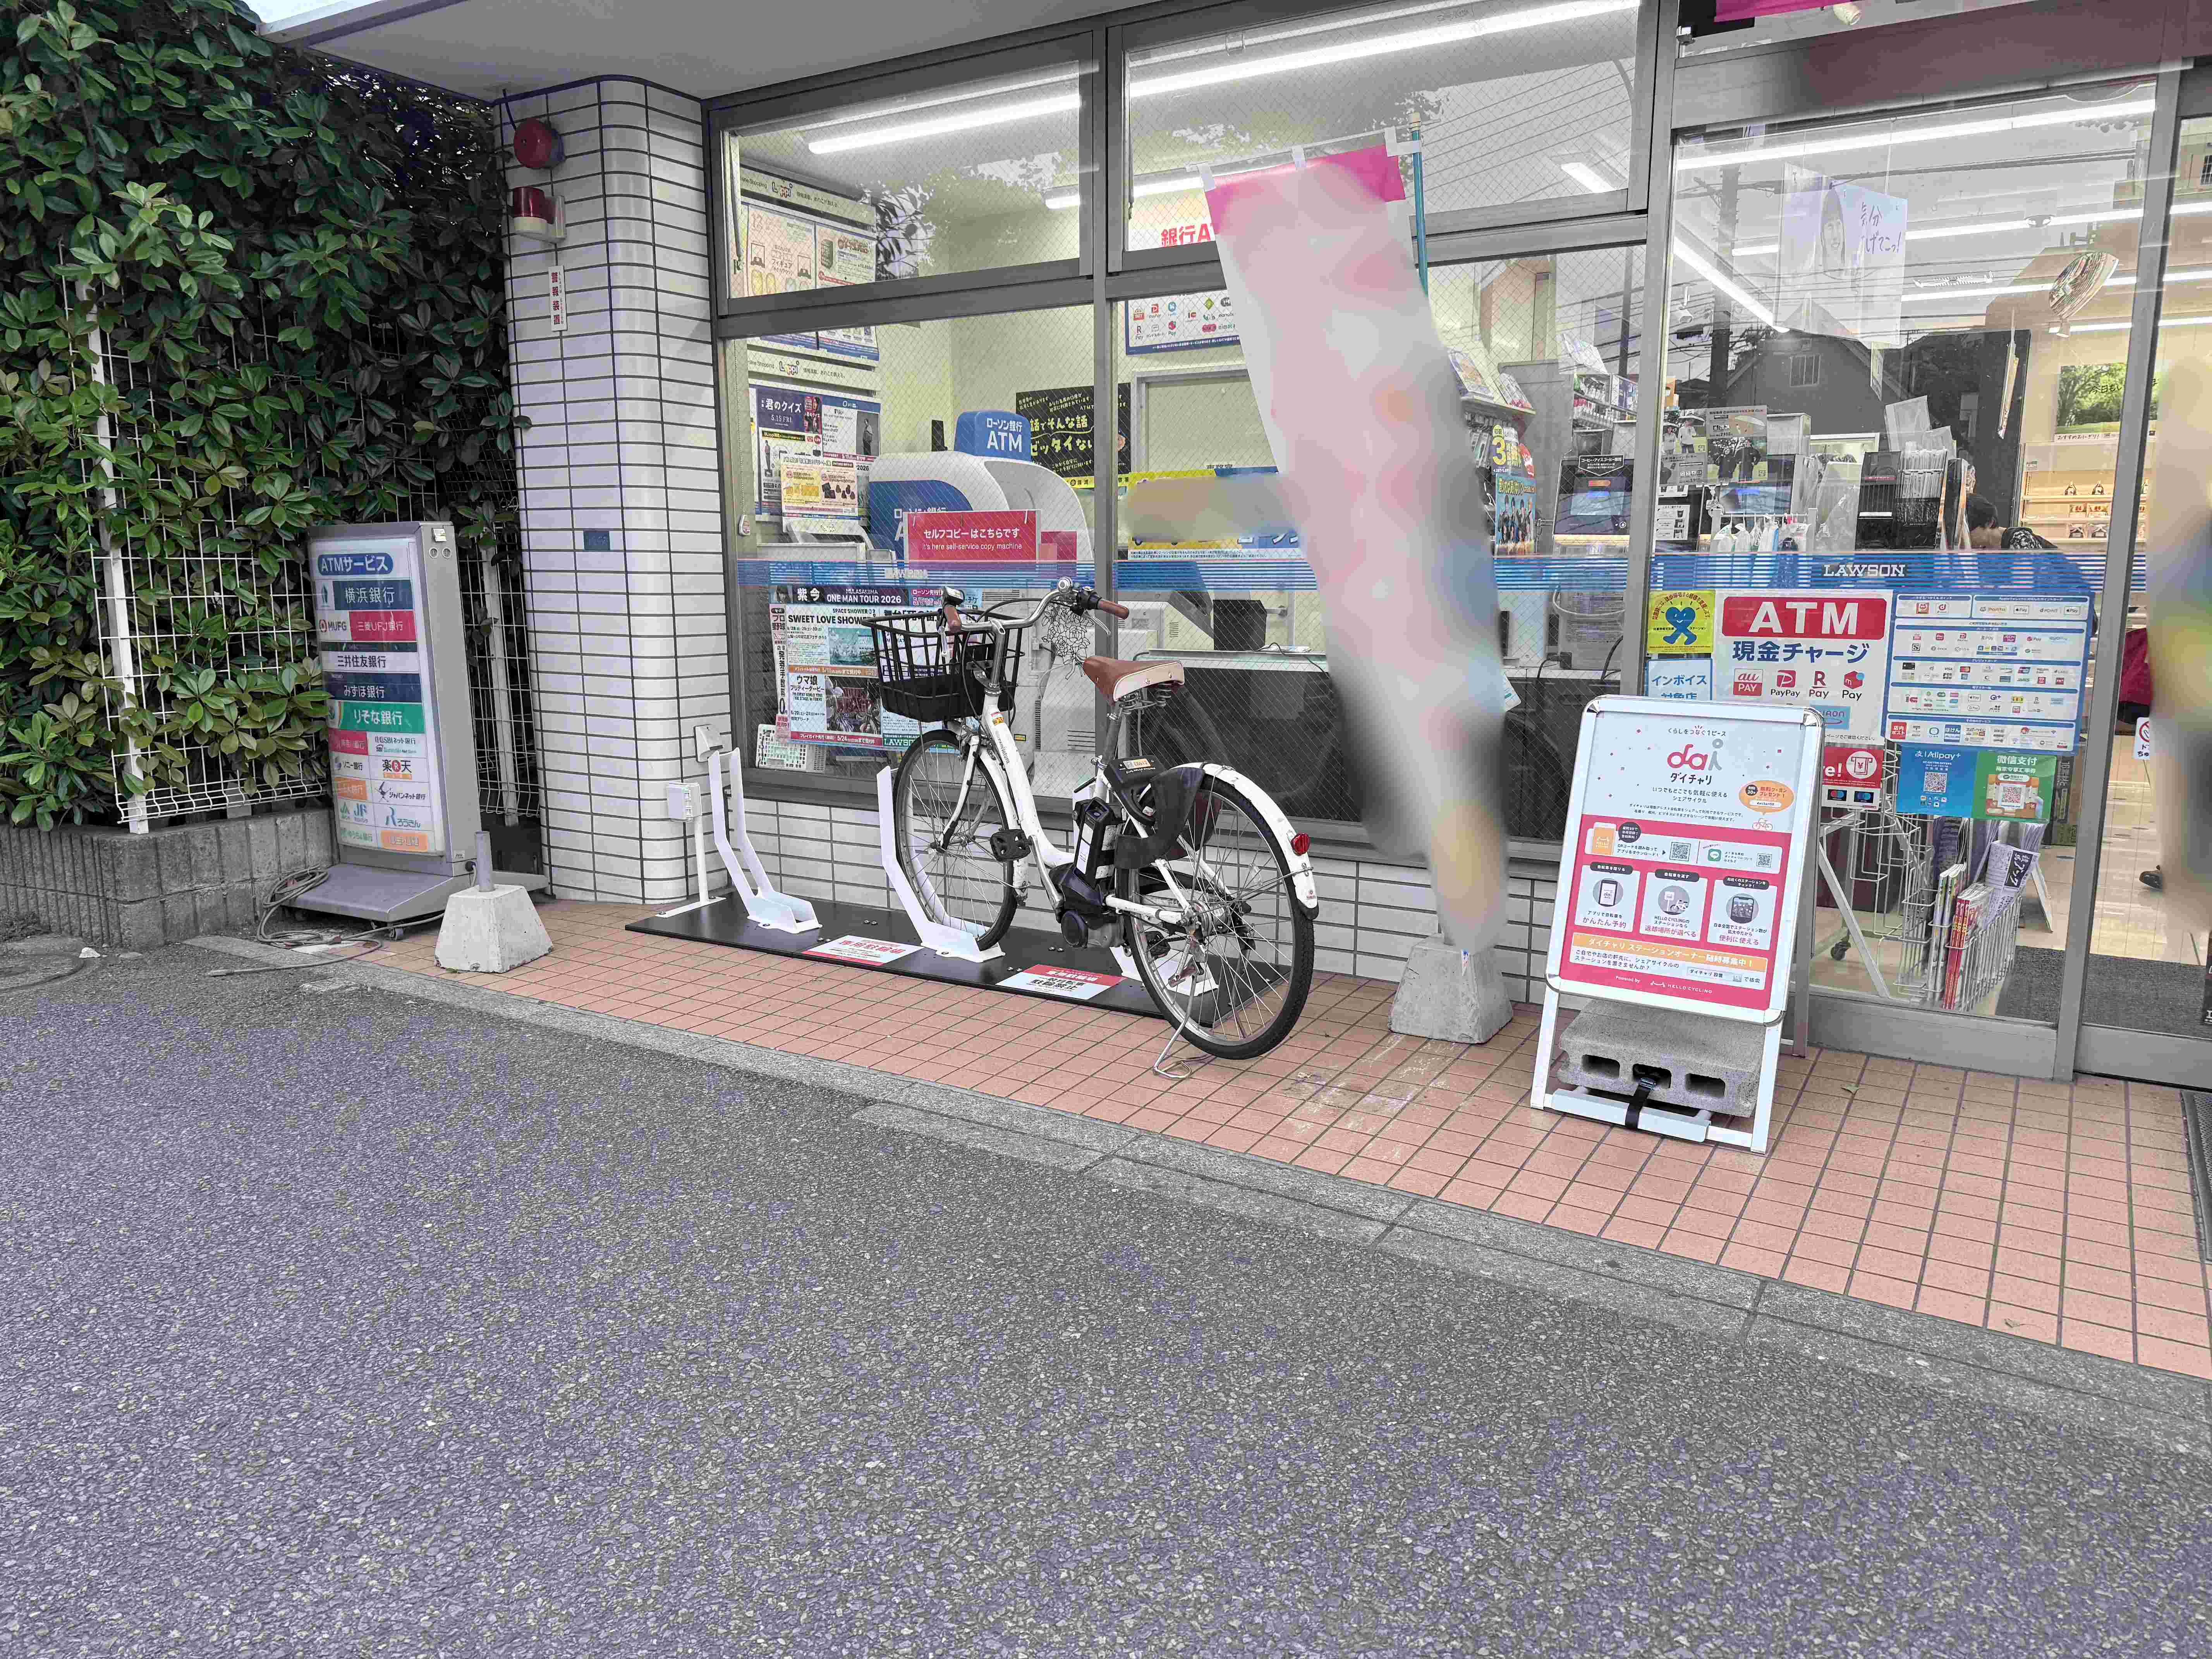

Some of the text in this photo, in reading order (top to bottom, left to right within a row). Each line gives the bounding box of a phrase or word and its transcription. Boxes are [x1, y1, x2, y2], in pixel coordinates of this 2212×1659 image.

[1161, 223, 1214, 247] 銀行A
[986, 418, 1023, 433] ローソン銀行
[986, 431, 1023, 453] ATM
[321, 555, 388, 572] ATMサービス
[1823, 564, 1906, 577] LAWSON
[345, 587, 395, 604] 横浜銀行
[860, 595, 879, 603] TOUR
[881, 595, 902, 603] 2026
[788, 615, 870, 625] SWEET LOVE SHOW
[1748, 601, 1860, 636] ATM
[328, 621, 347, 631] MUFG
[1731, 640, 1870, 664] 現金チャージ
[337, 655, 386, 668] 三井住友銀行
[797, 675, 817, 685] ウマ娘
[1652, 675, 1707, 686] インボイス
[1738, 672, 1760, 682] au
[343, 685, 385, 699] みずほ銀行
[1738, 683, 1757, 692] PAY
[1771, 689, 1801, 698] PayPay
[1809, 689, 1829, 699] Pay
[1842, 690, 1862, 701] Pay
[354, 709, 403, 725] りそな銀行
[1668, 728, 1726, 736] くらしをつなぐ1ピース
[1671, 772, 1712, 785] ダイチャリ
[1653, 787, 1728, 798] いつでもどこでも気軽に使える
[1588, 910, 1623, 919] アプリで自転車を
[1583, 916, 1627, 929] かんたん予約
[1645, 925, 1697, 937] 返却場所が選べる
[1589, 938, 1625, 949] ダイチャリ
[1719, 934, 1759, 945] 便利に使える
[1689, 968, 1712, 977] ダイチャリ
